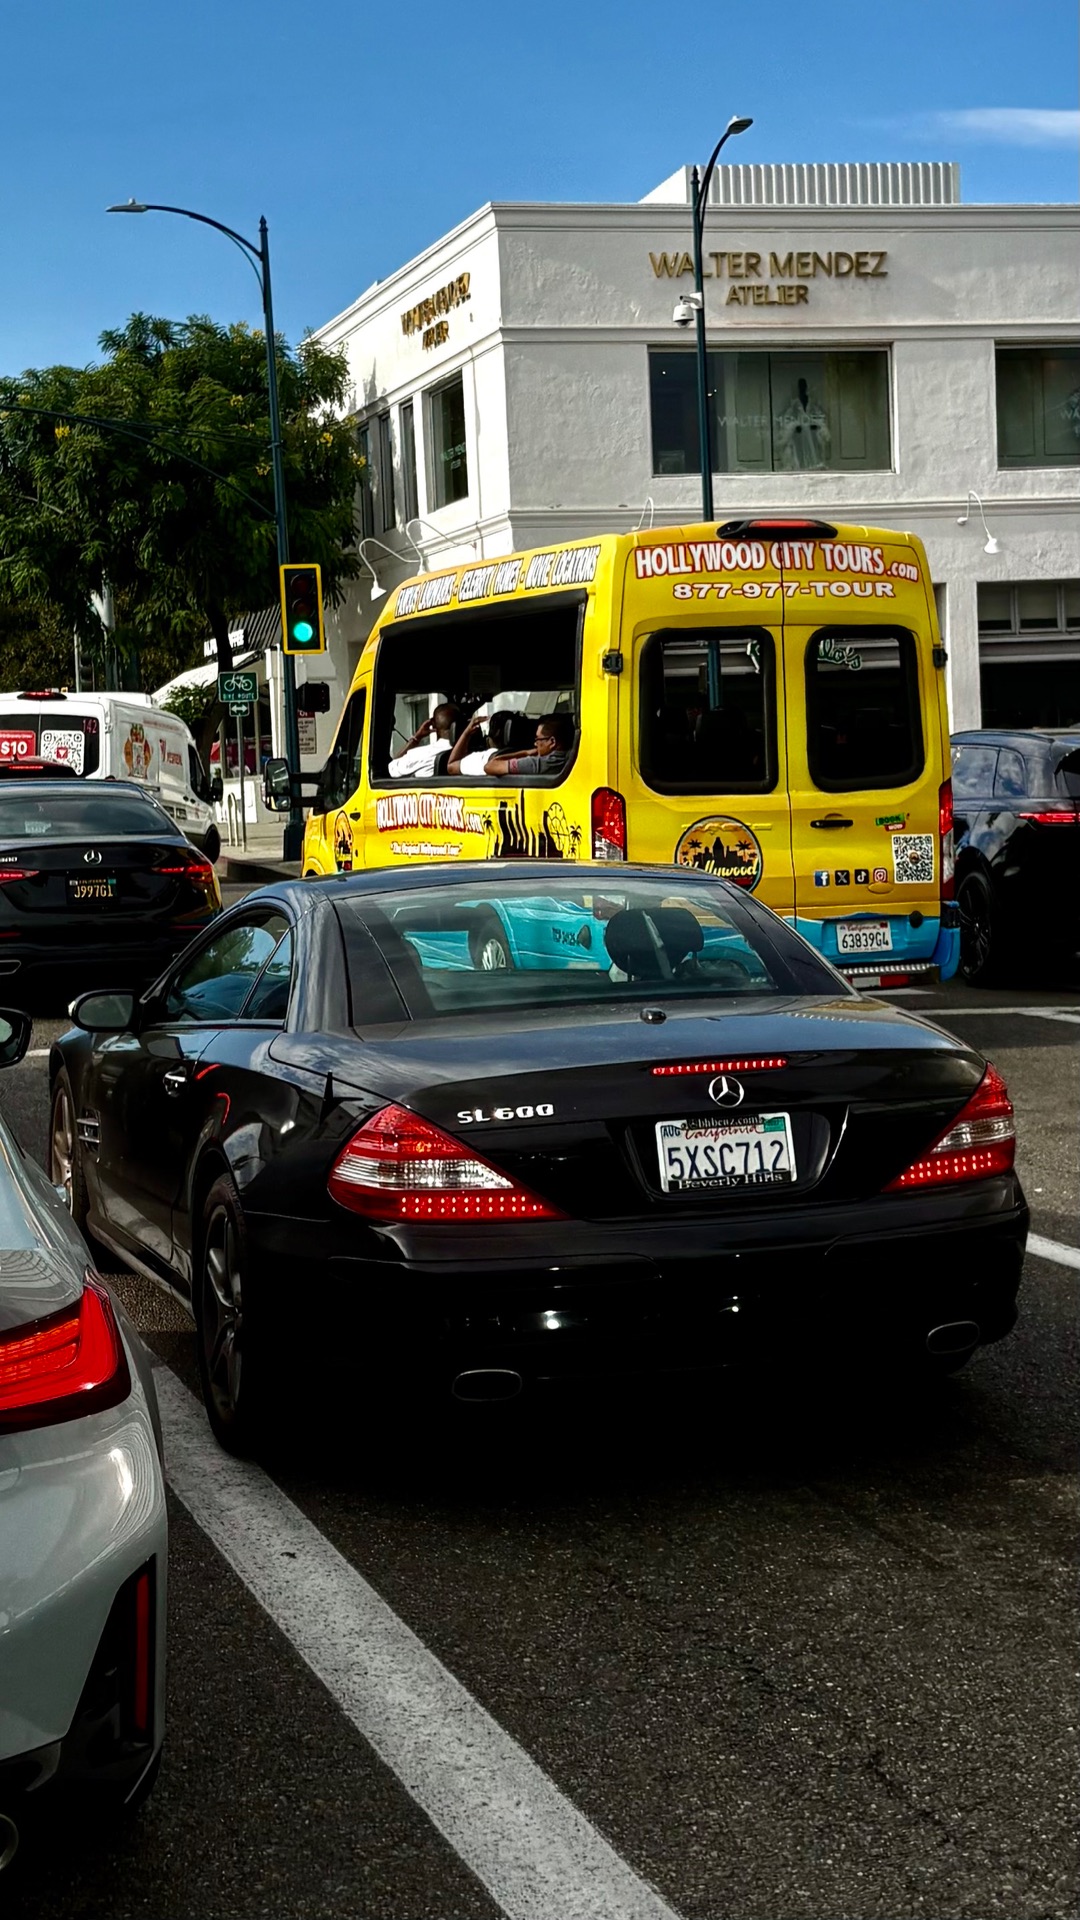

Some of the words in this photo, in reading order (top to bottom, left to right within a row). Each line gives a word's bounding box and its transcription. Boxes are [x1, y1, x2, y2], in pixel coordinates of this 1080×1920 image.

[769, 251, 888, 278] MENDEZ
[725, 284, 809, 306] ATELIER
[551, 544, 601, 586] LOCATIONS
[635, 542, 765, 579] HOLLYWOOD
[770, 541, 815, 570] CITY
[820, 543, 885, 576] TOURS
[673, 581, 897, 599] 877-977-TOUR
[83, 719, 97, 733] 142
[377, 793, 419, 832] HOLLYWOOD
[418, 792, 437, 829] CITY
[74, 884, 113, 899] J997G1
[842, 932, 889, 949] 63839G4
[663, 1128, 681, 1139] AUG
[685, 1125, 764, 1142] California
[667, 1140, 787, 1180] 5XSC712
[679, 1175, 740, 1190] Beverly
[744, 1172, 783, 1185] Hills
